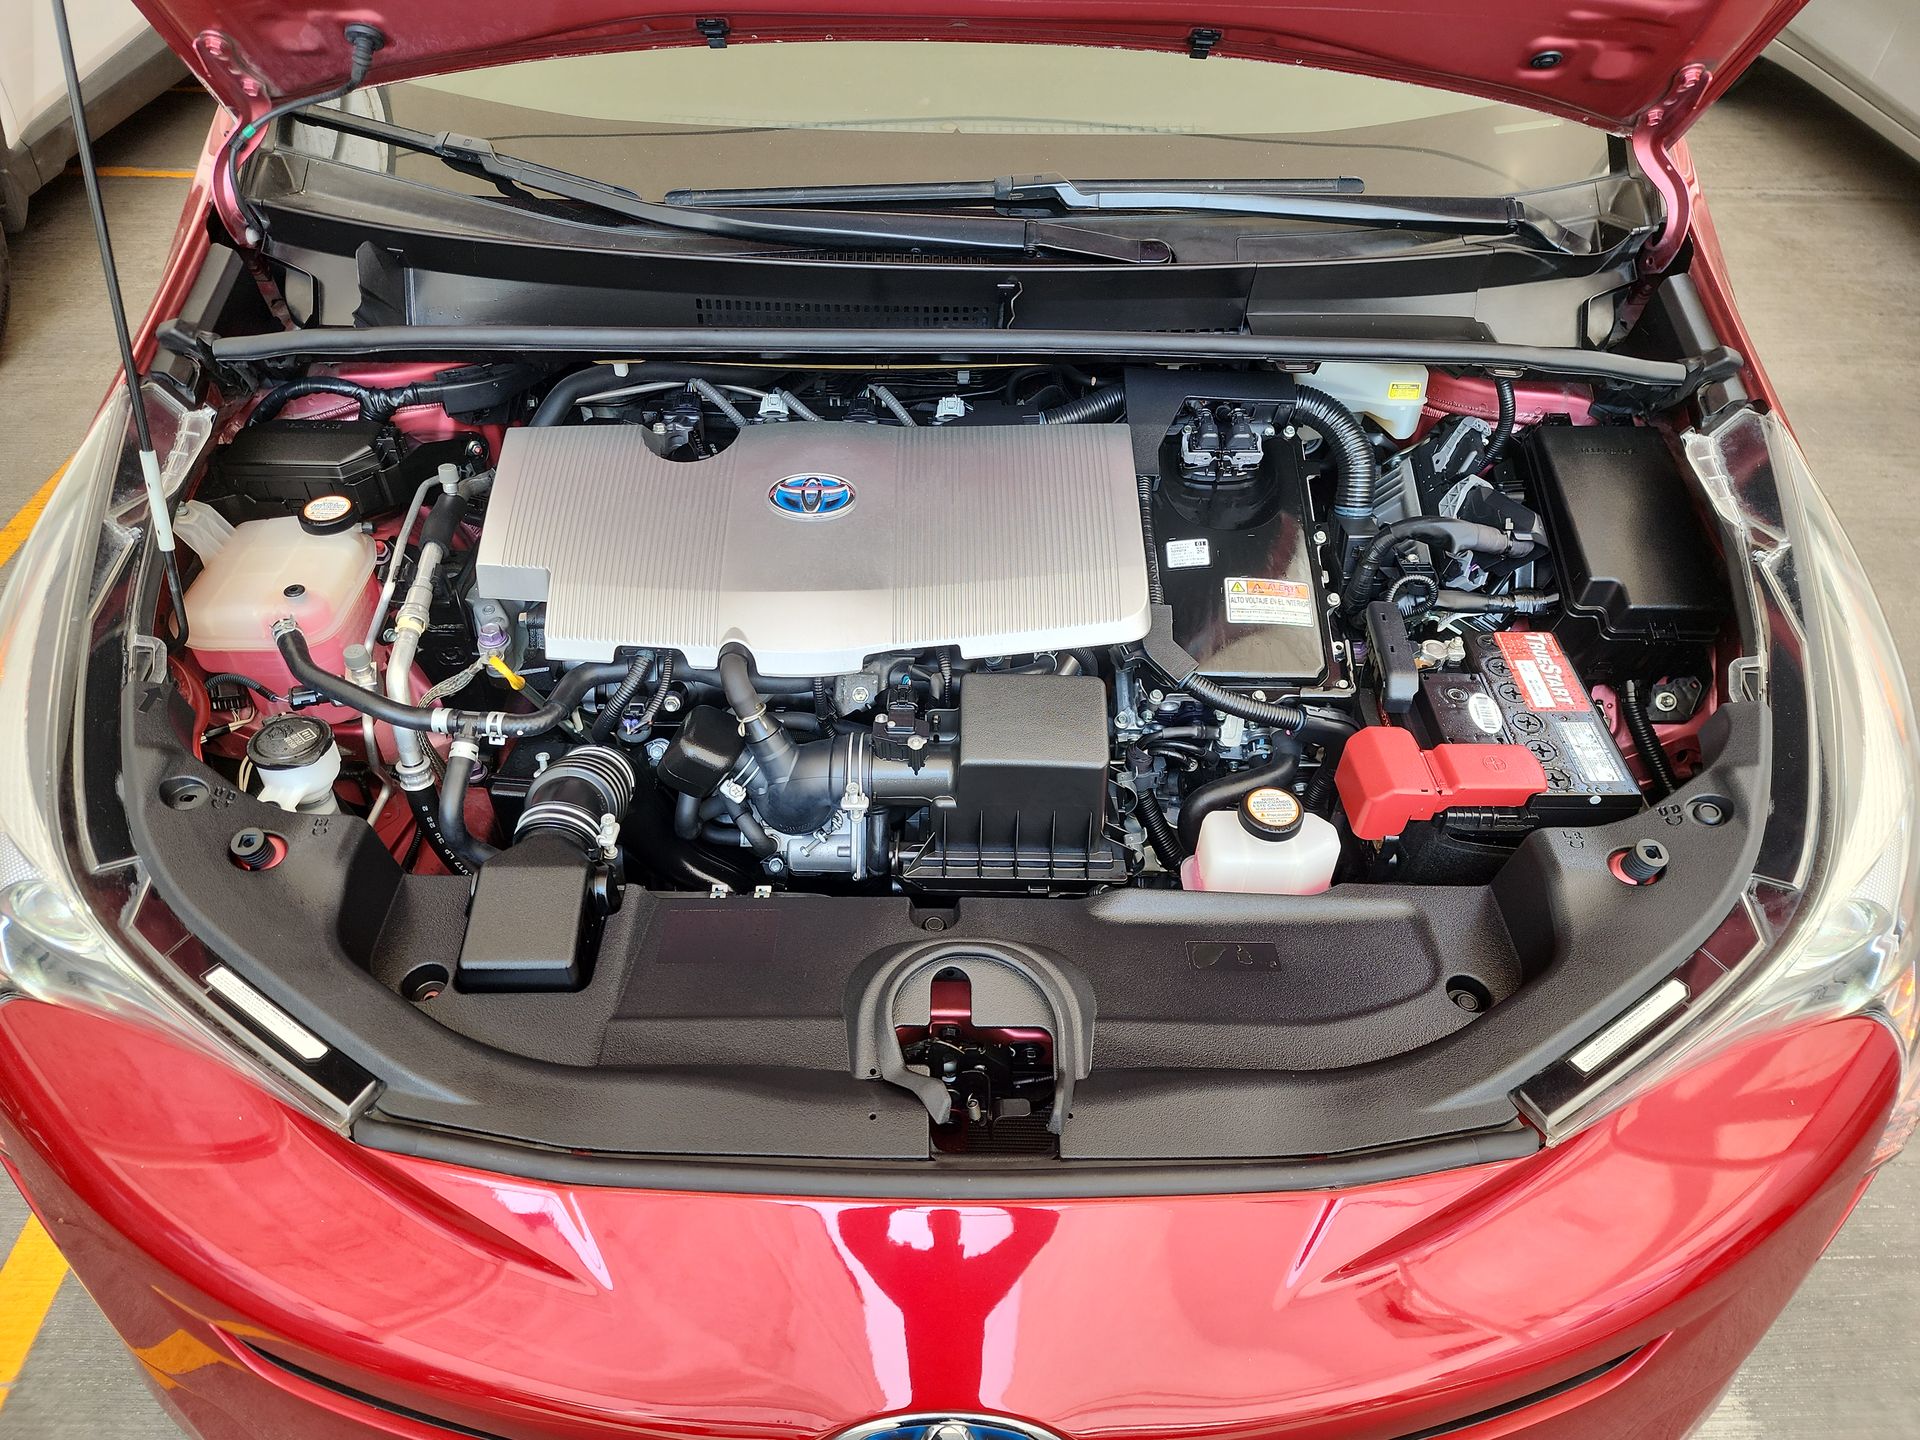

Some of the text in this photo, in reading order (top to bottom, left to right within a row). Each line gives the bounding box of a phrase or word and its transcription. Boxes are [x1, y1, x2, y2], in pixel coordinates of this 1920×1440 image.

[1230, 596, 1244, 604] ALTO
[1245, 597, 1269, 605] VOLTAJE
[1524, 633, 1575, 705] TRUESTART
[426, 816, 436, 829] 22
[434, 832, 445, 845] 3U
[444, 848, 456, 860] LP
